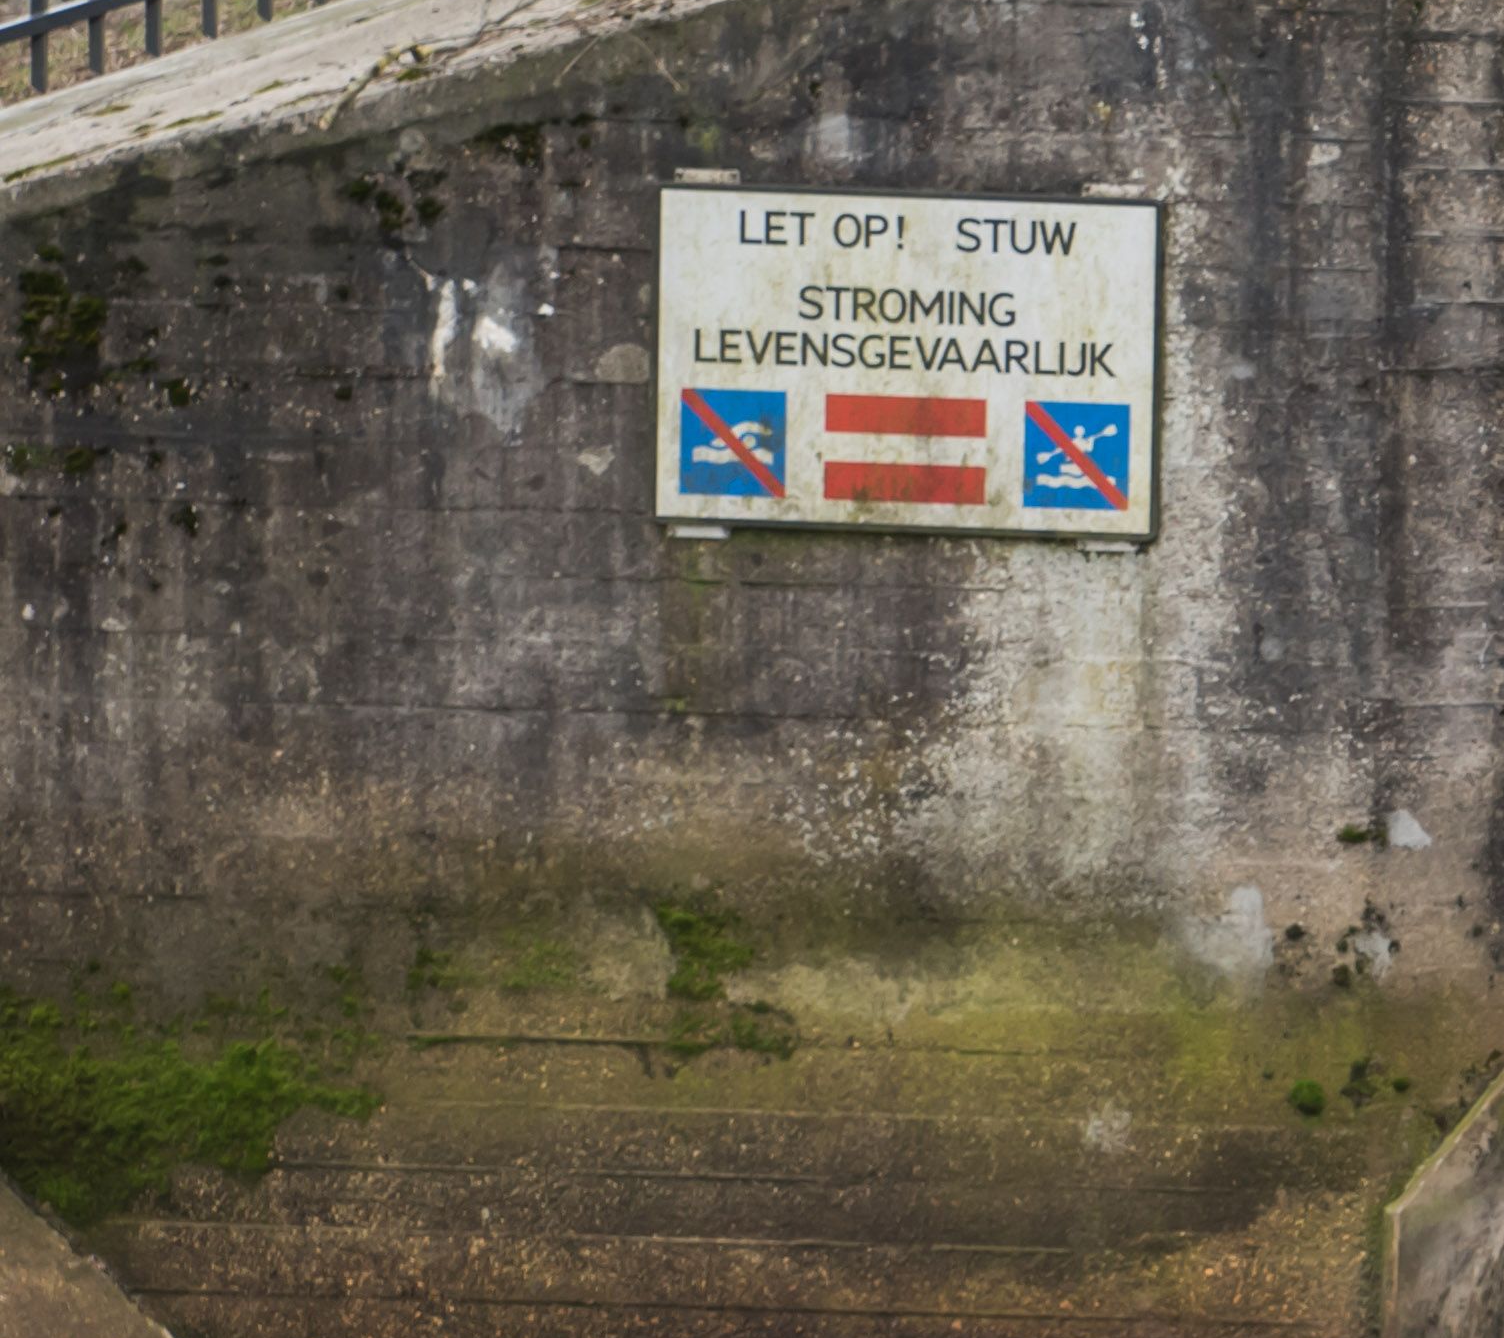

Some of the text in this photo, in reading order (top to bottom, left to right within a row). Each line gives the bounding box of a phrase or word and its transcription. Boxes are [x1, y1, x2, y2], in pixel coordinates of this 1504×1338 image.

[739, 210, 1077, 255] LET OP! STUW
[798, 285, 1017, 326] STROMING
[694, 329, 1117, 377] LEVENSGEVAARLIJK
